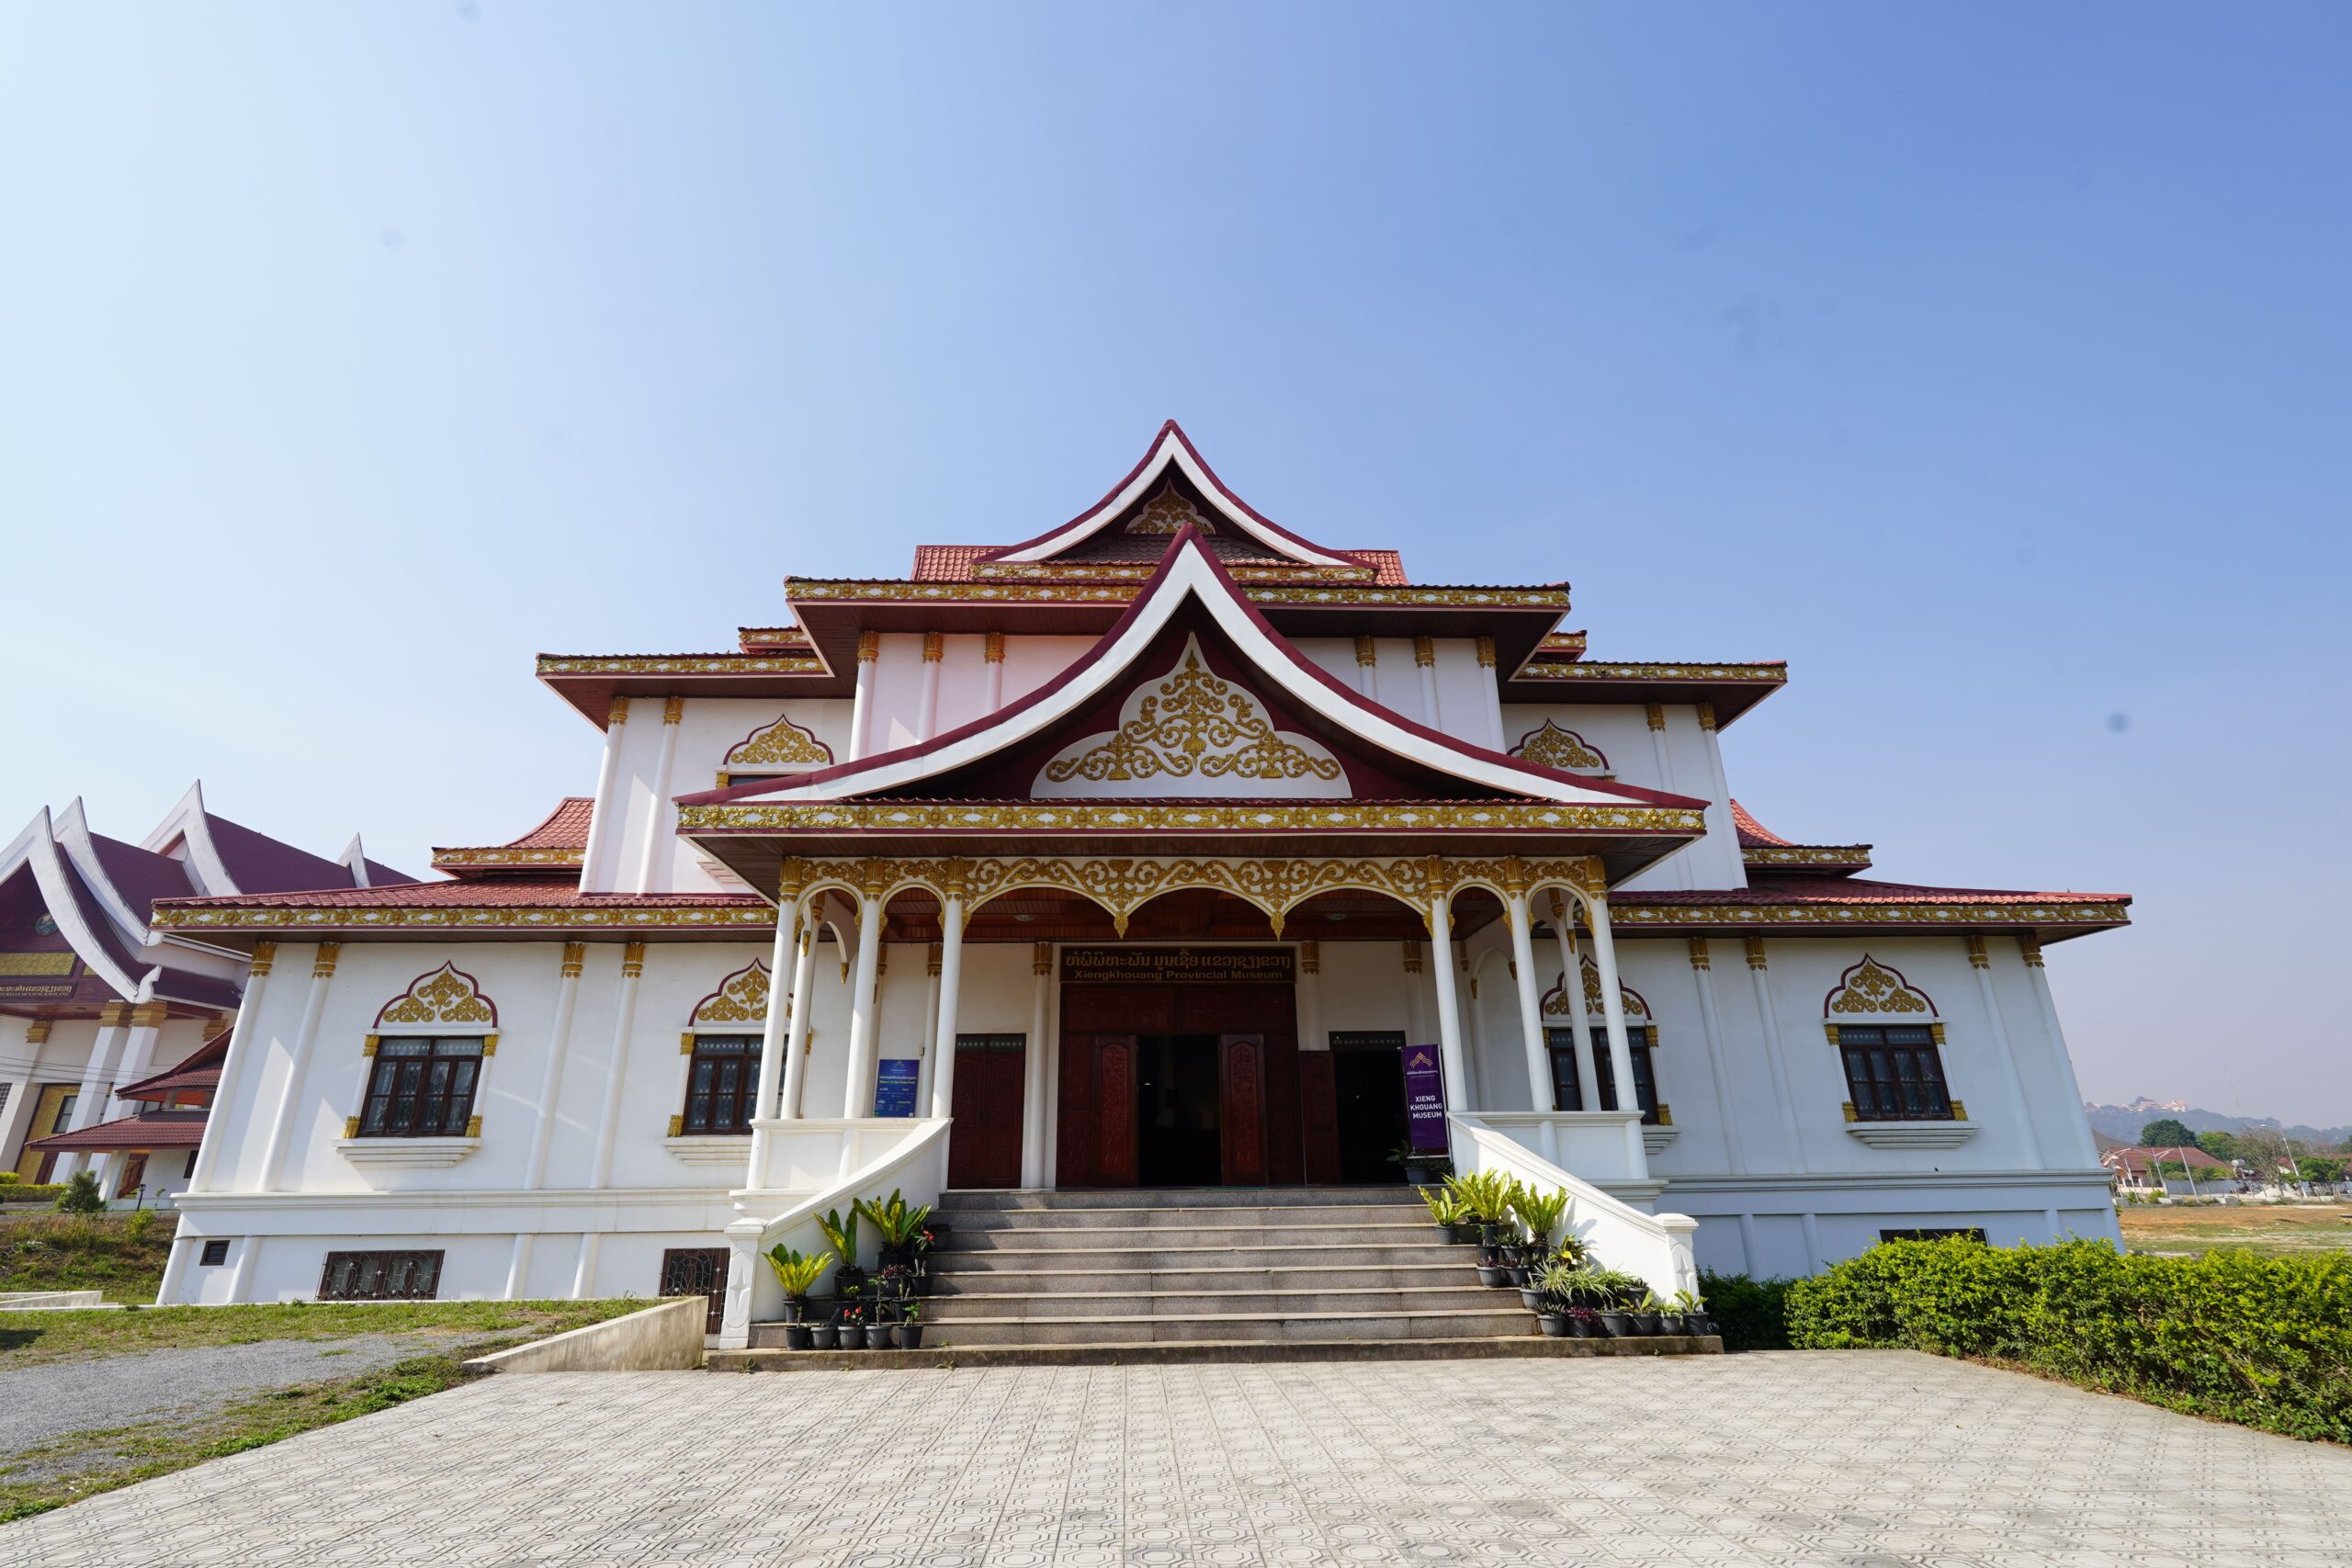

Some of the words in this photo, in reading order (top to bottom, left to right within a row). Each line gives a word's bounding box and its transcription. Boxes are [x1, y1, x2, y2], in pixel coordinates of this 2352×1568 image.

[1074, 970, 1162, 980] Xiengkhouang
[1166, 970, 1227, 979] Provincial
[1230, 970, 1283, 979] Museum
[1409, 1102, 1442, 1111] KHOUANG
[1412, 1111, 1442, 1119] MUSEUM
